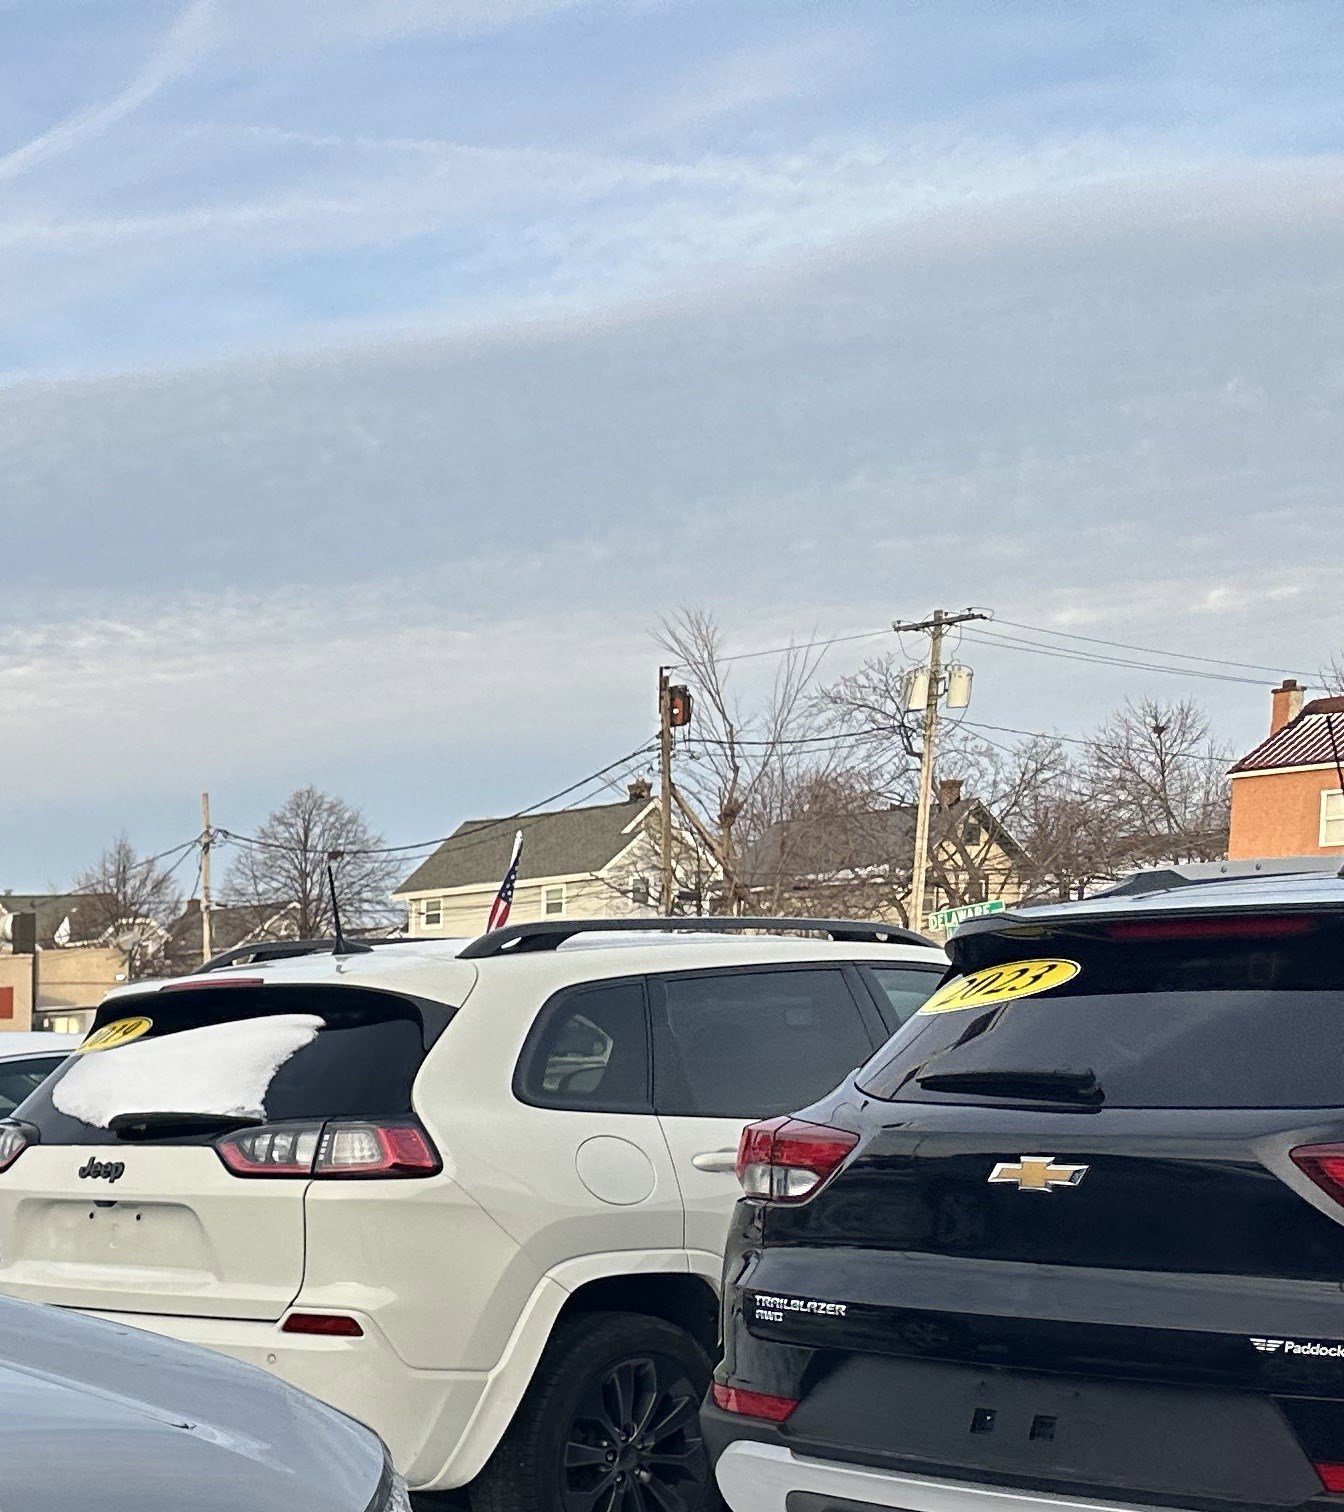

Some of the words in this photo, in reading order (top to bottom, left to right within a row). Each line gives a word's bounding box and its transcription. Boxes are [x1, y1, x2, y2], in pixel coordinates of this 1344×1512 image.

[929, 905, 990, 930] DELAWARE
[934, 964, 1058, 1008] 2023
[79, 1157, 125, 1183] Jeep
[755, 1295, 846, 1316] TRAILBLAZER
[756, 1309, 783, 1322] AWD
